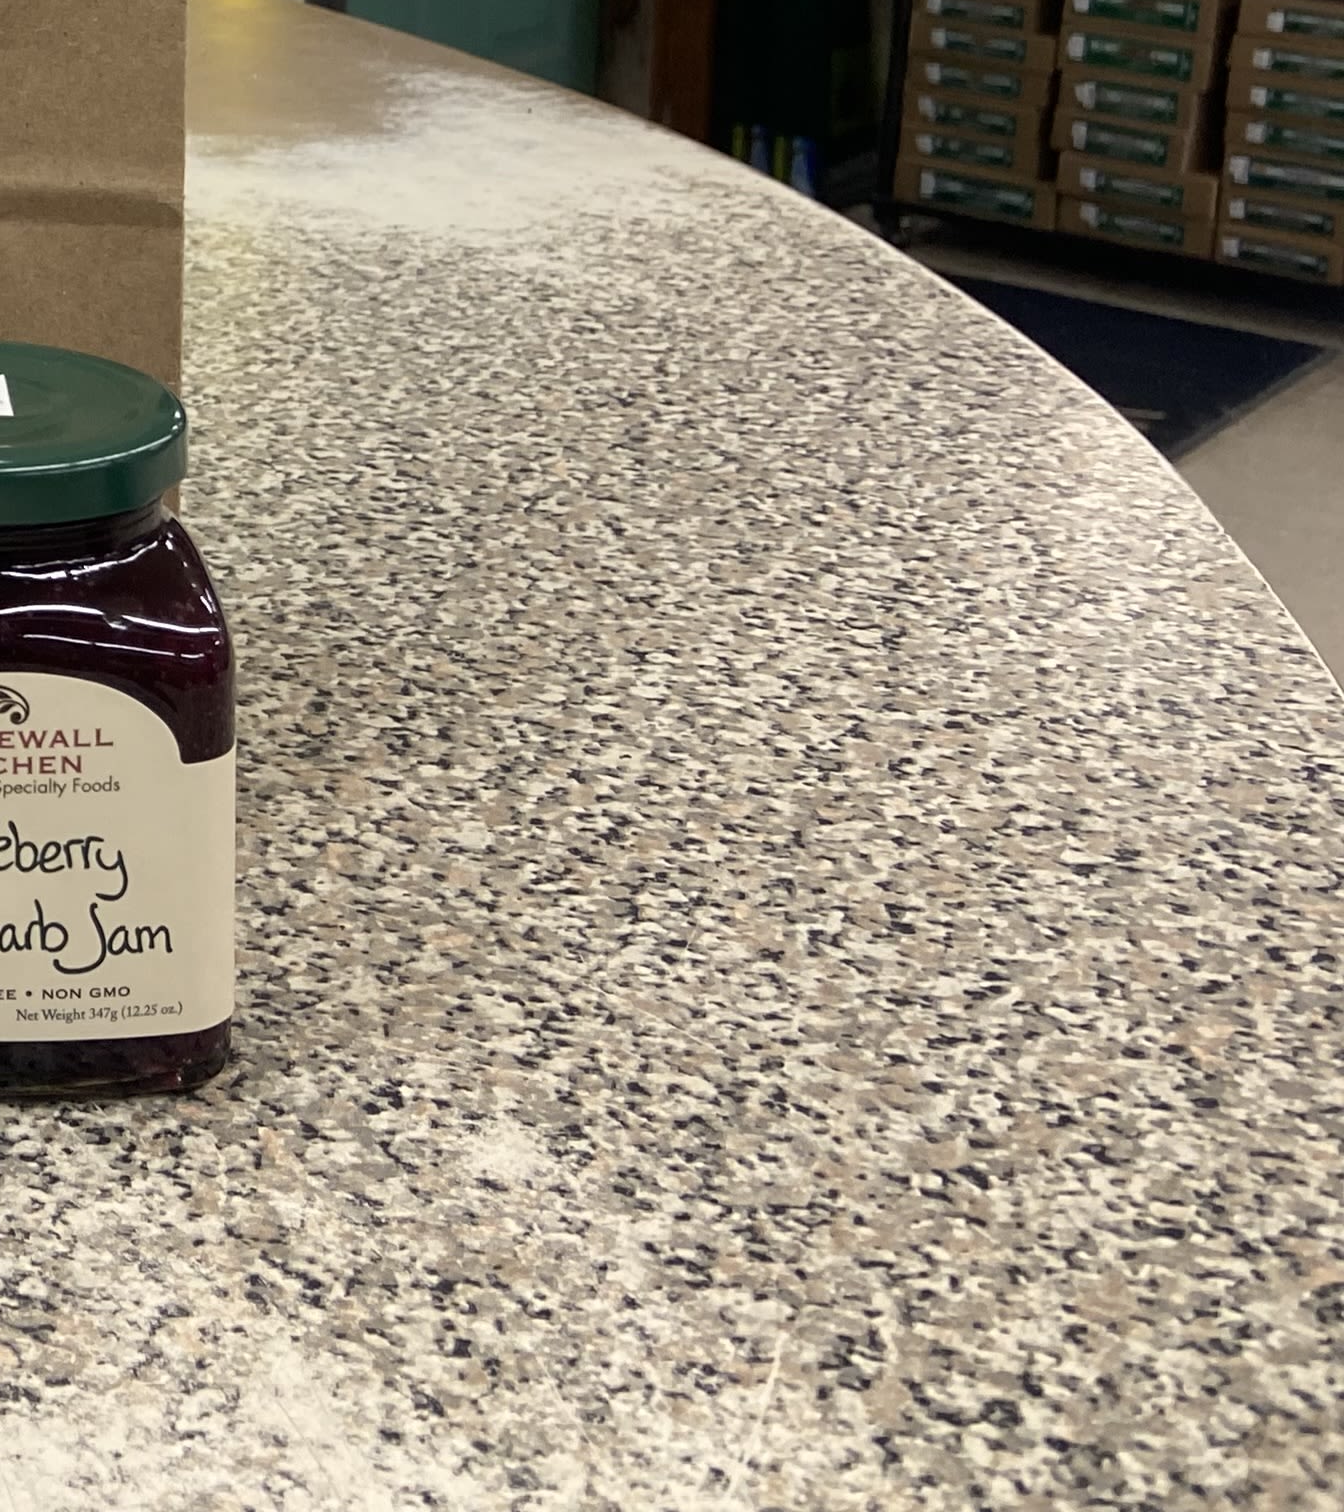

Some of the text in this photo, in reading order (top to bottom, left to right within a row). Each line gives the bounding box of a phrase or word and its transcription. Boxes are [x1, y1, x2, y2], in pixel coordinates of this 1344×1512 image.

[72, 775, 120, 793] Foods
[52, 902, 173, 974] Jam
[42, 988, 82, 1000] NON
[89, 986, 130, 998] GMO
[15, 1009, 38, 1022] Net
[41, 1007, 86, 1023] Weight
[88, 1005, 118, 1022] 347g
[120, 1003, 158, 1020] (12.25
